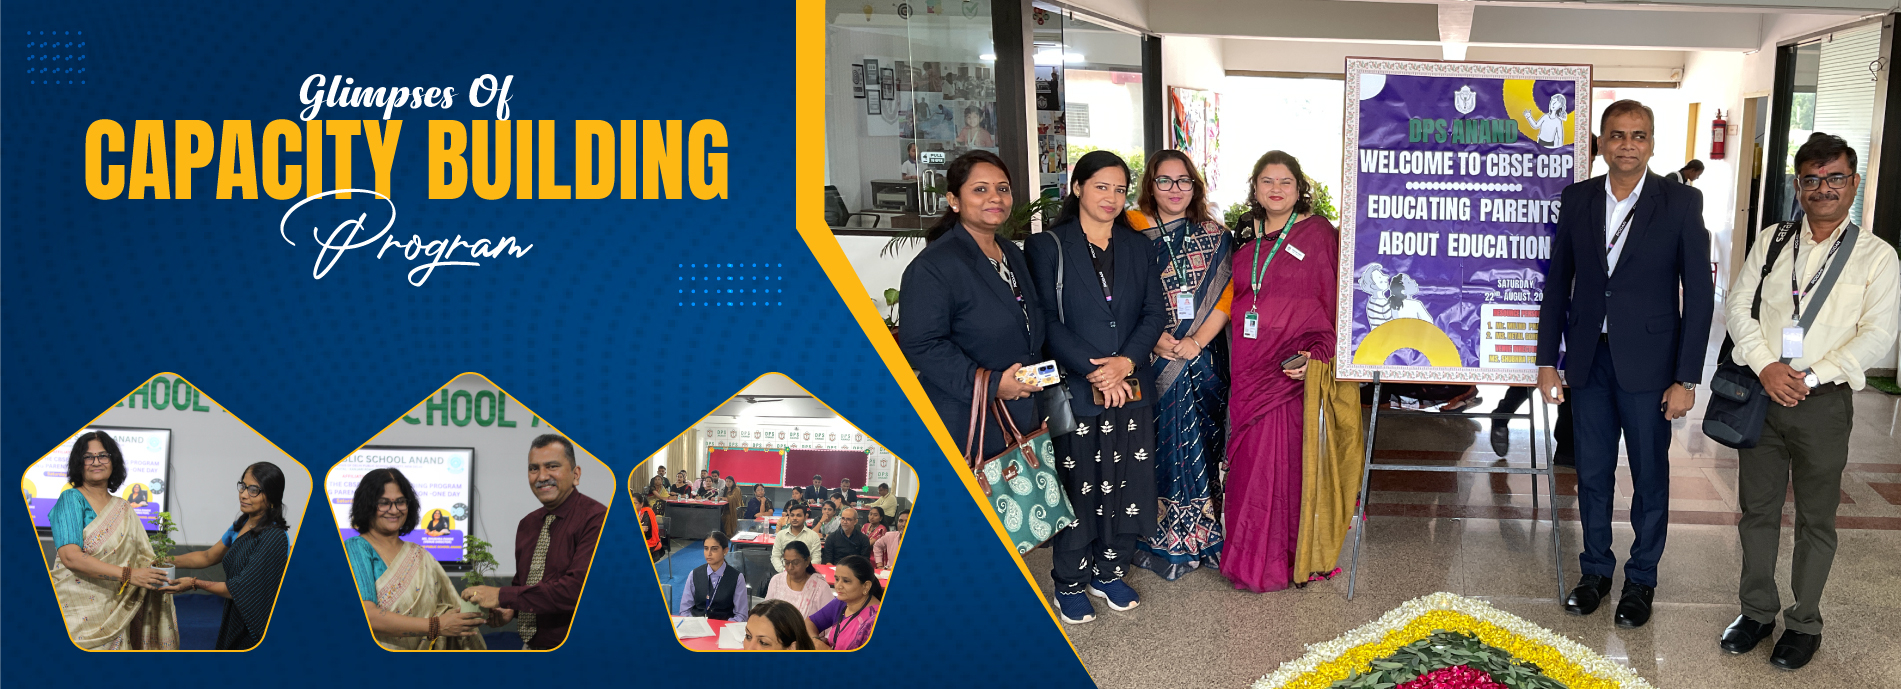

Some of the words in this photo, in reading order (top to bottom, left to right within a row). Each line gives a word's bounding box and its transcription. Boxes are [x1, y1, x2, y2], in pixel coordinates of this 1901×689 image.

[1409, 118, 1447, 143] DPS
[1451, 118, 1518, 144] ANAND
[1360, 149, 1454, 175] WELCOME
[1457, 151, 1481, 176] TO
[1486, 153, 1534, 178] CBSE
[1536, 154, 1574, 178] CBP
[1367, 194, 1471, 221] EDUCATING
[1479, 198, 1561, 224] PARENTS
[1377, 231, 1440, 257] ABOUT
[1447, 233, 1551, 260] EDUCATION
[1497, 279, 1534, 289] SATURDAY
[1503, 292, 1531, 302] AUGUST
[115, 376, 210, 413] HOOL
[366, 455, 406, 464] SCHOOL
[408, 456, 444, 465] ANAND
